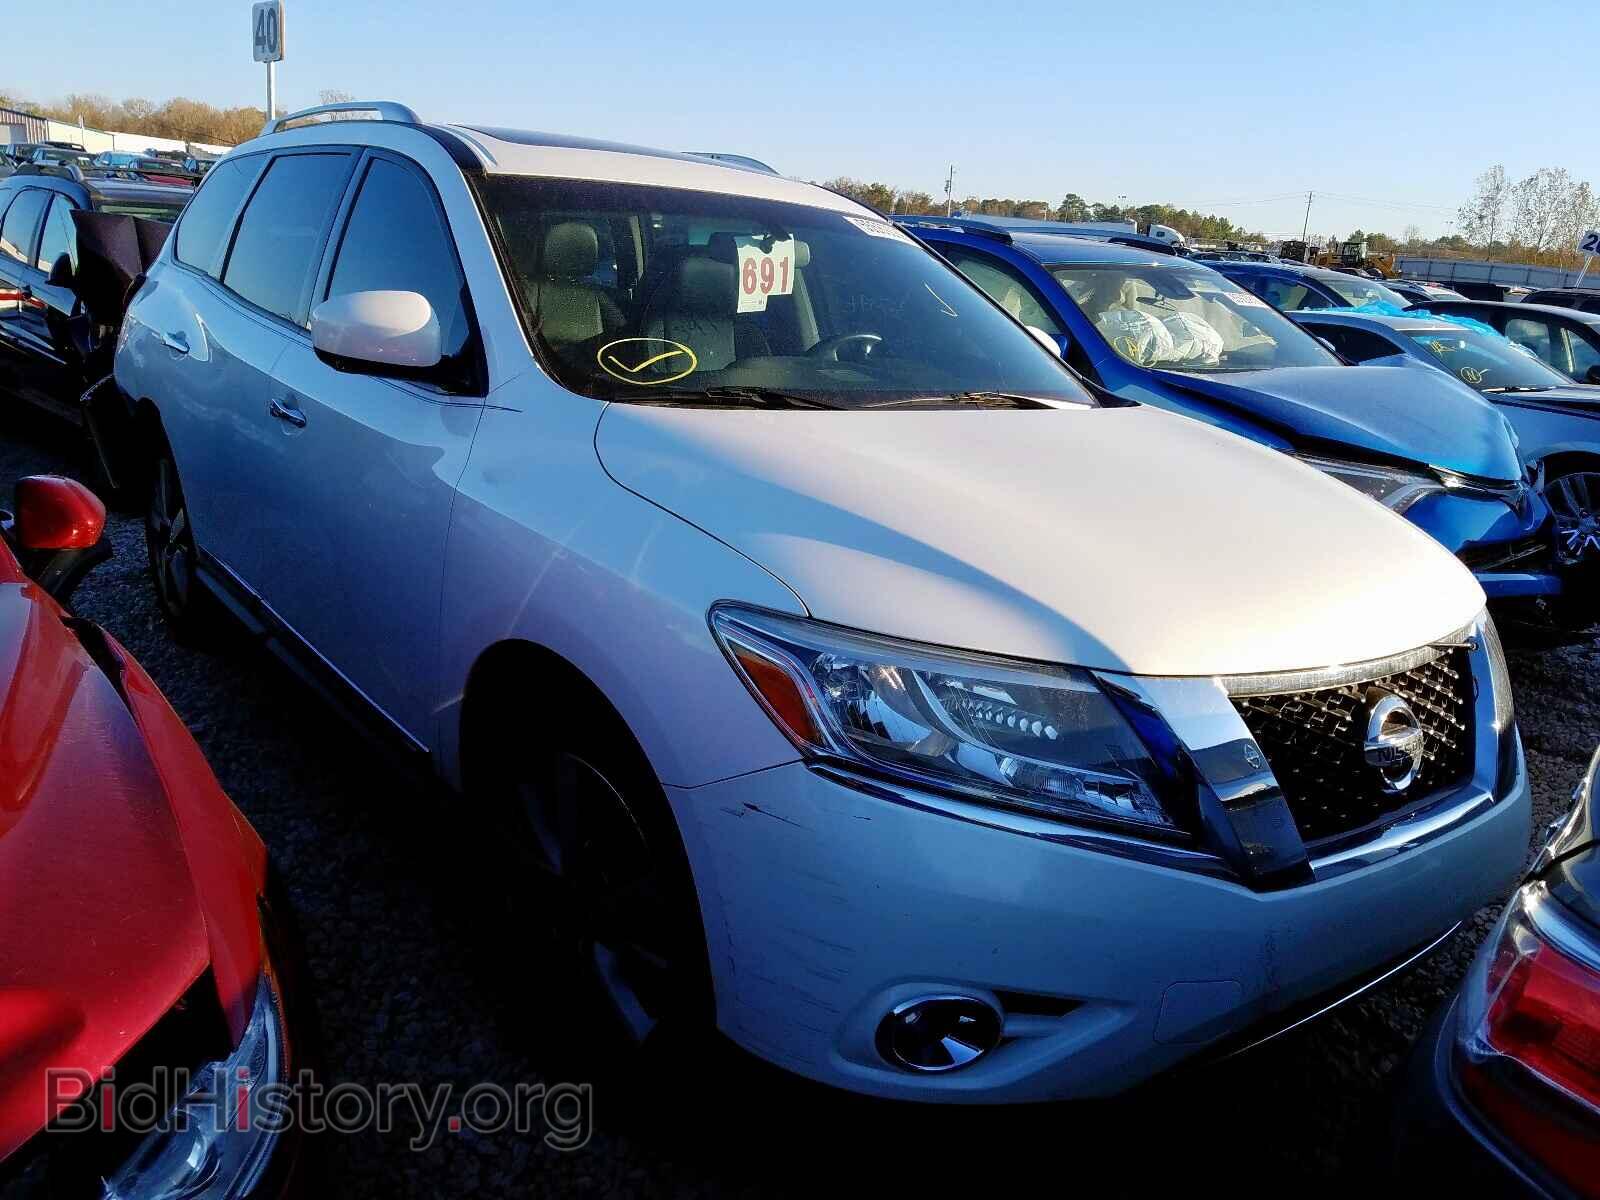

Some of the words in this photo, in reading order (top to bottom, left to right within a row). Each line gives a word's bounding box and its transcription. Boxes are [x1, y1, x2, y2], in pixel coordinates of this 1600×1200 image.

[255, 8, 277, 53] 40
[1582, 234, 1600, 254] 2
[742, 256, 789, 295] 691
